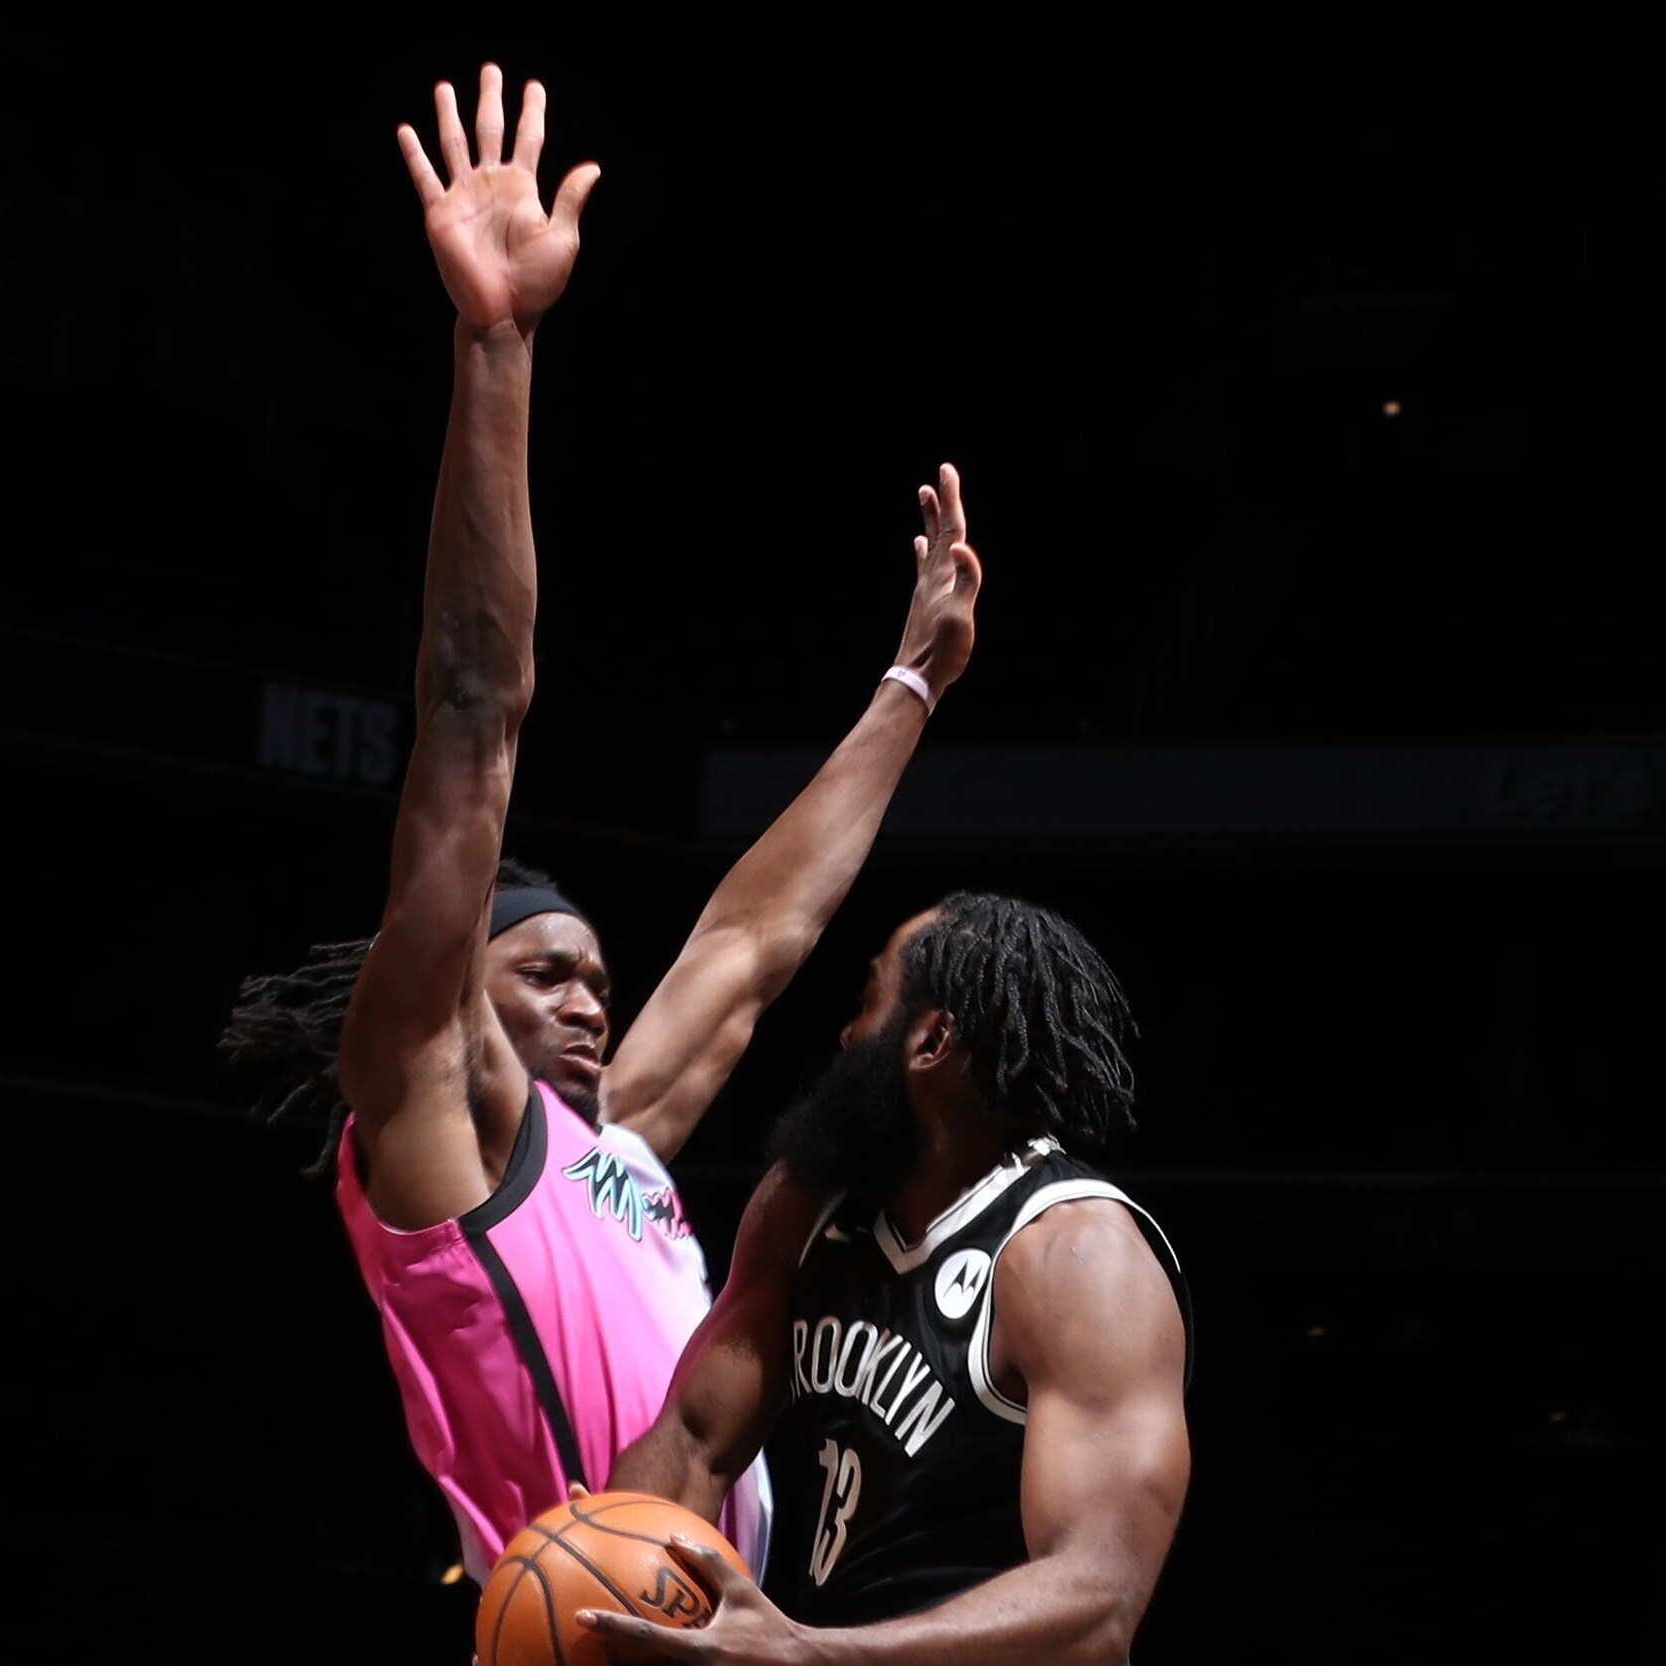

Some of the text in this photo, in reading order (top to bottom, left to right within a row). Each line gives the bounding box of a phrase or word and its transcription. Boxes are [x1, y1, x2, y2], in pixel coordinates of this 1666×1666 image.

[259, 683, 399, 783] NETS
[790, 1315, 956, 1458] ROOKLYN
[809, 1437, 862, 1587] 13
